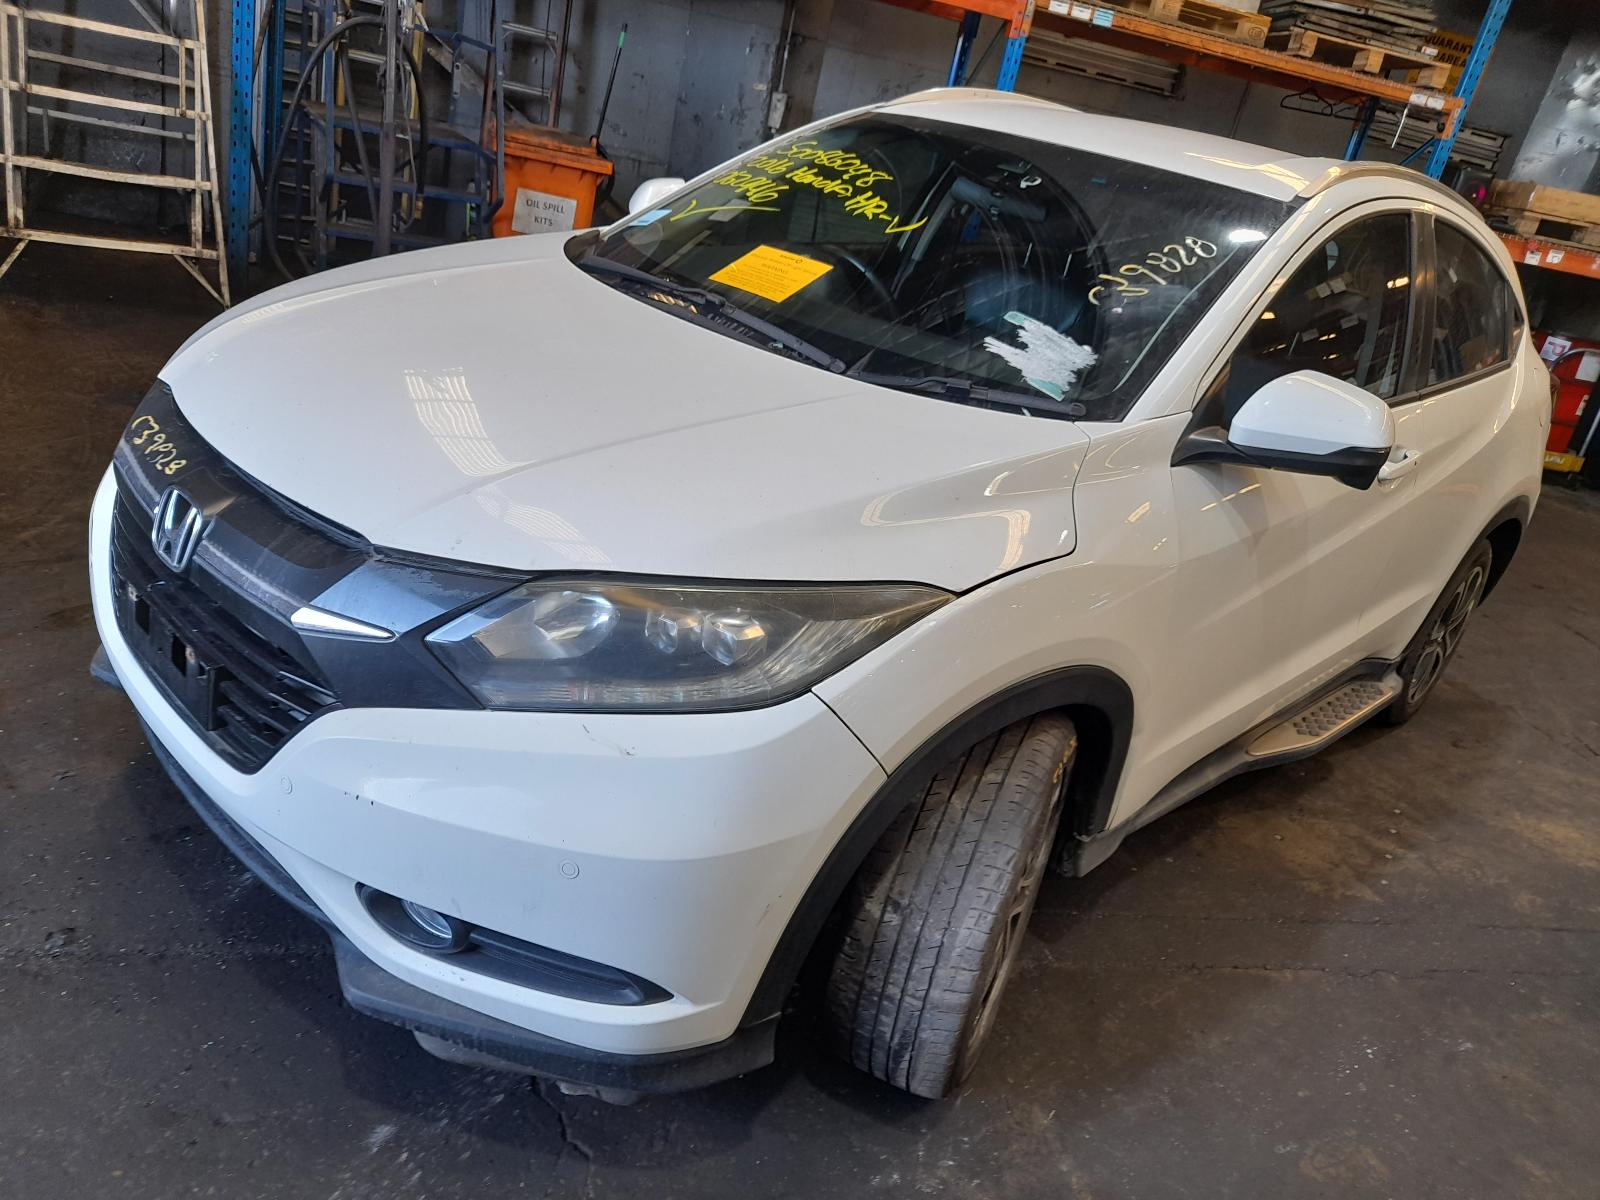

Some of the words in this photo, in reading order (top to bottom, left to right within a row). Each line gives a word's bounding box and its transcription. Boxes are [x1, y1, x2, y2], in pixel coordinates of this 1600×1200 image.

[526, 199, 540, 209] OIL
[543, 201, 565, 214] SPILL
[534, 215, 553, 226] KITS
